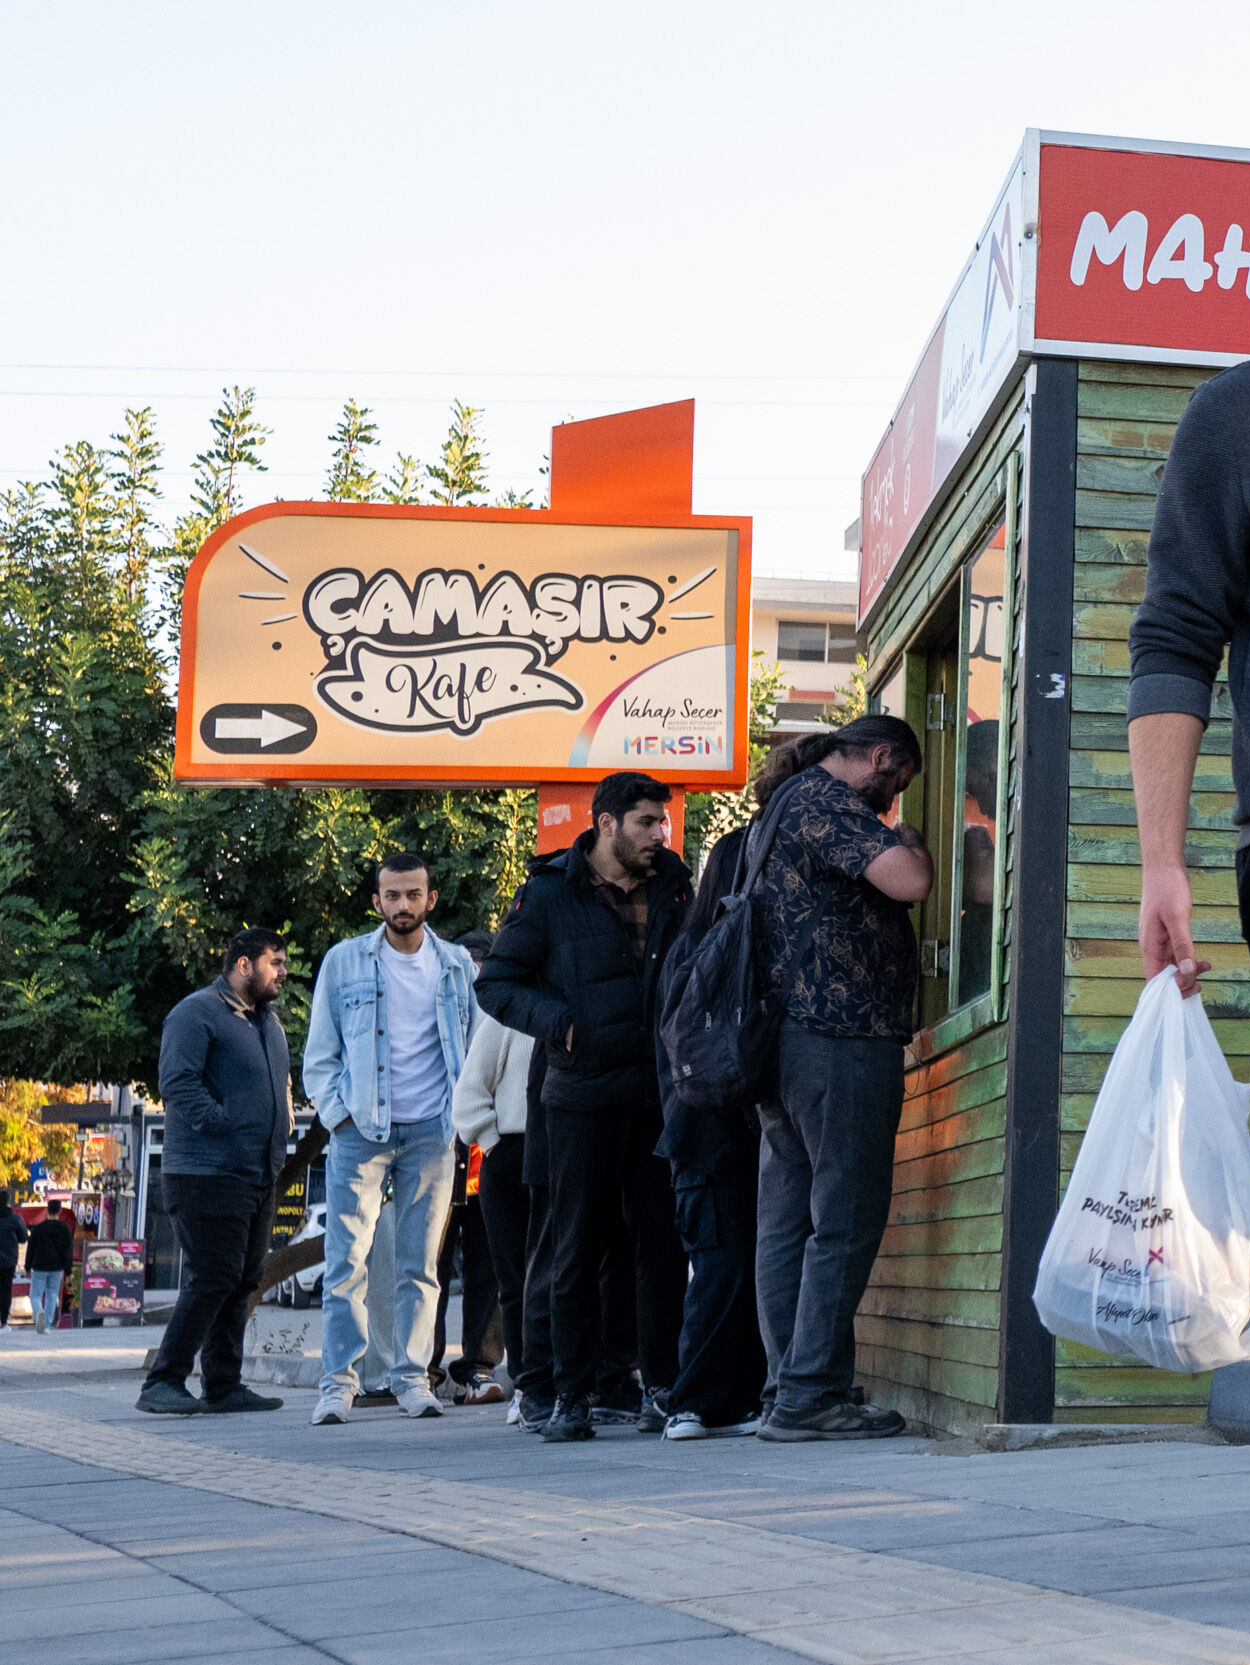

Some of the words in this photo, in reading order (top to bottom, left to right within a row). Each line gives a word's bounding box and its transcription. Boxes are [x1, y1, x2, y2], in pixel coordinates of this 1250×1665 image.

[303, 568, 663, 655] ÇAMAŞIR
[385, 658, 497, 724] Kafe
[623, 696, 676, 728] Vahap
